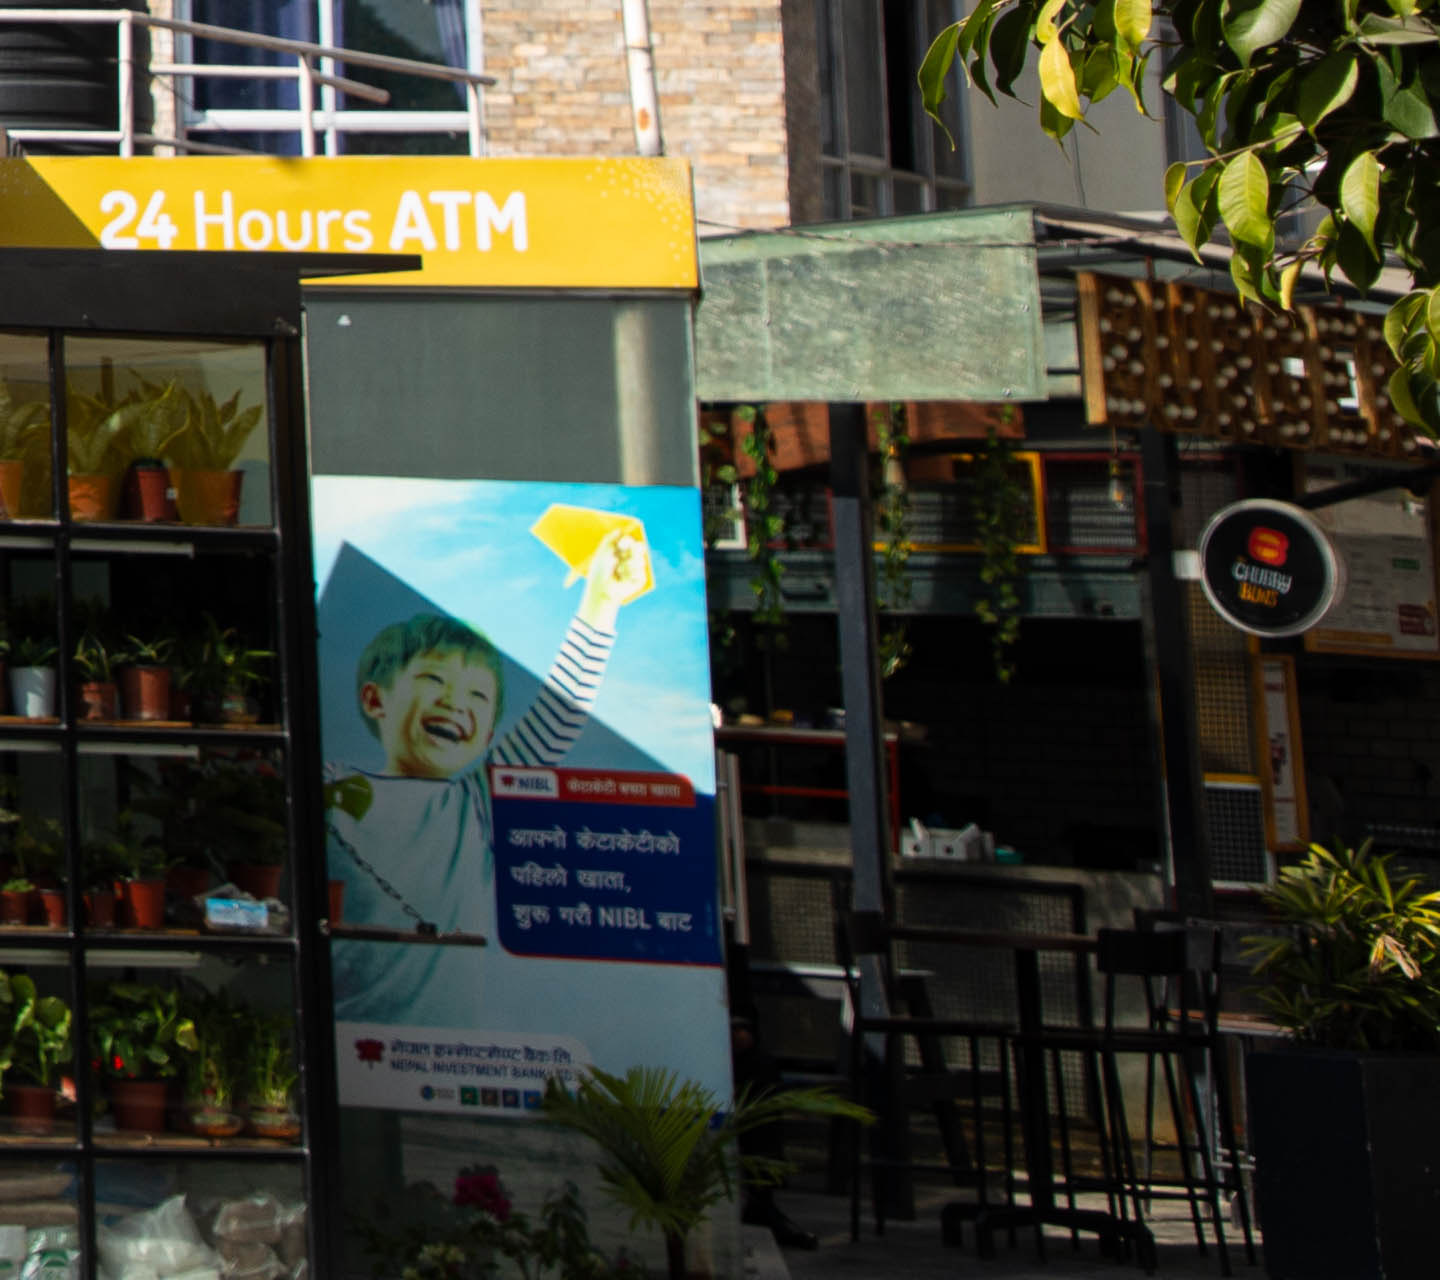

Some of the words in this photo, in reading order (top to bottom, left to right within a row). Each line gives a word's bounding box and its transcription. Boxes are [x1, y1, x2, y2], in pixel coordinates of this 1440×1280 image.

[99, 190, 178, 250] 24
[193, 189, 373, 251] Hours
[389, 190, 528, 252] ATM
[1231, 561, 1293, 595] CHUBBY
[1239, 580, 1279, 608] BUNS
[518, 775, 553, 791] NIBL
[508, 824, 568, 849] आफ्नो
[576, 825, 680, 855] केटाकेटीको
[509, 861, 568, 887] पहिलो
[576, 869, 632, 893] खाता,
[599, 907, 652, 929] NIBL
[656, 911, 693, 932] बाट
[390, 1058, 429, 1073] NEPAL
[433, 1061, 508, 1078] INVESTMENT
[511, 1063, 546, 1079] BANK
